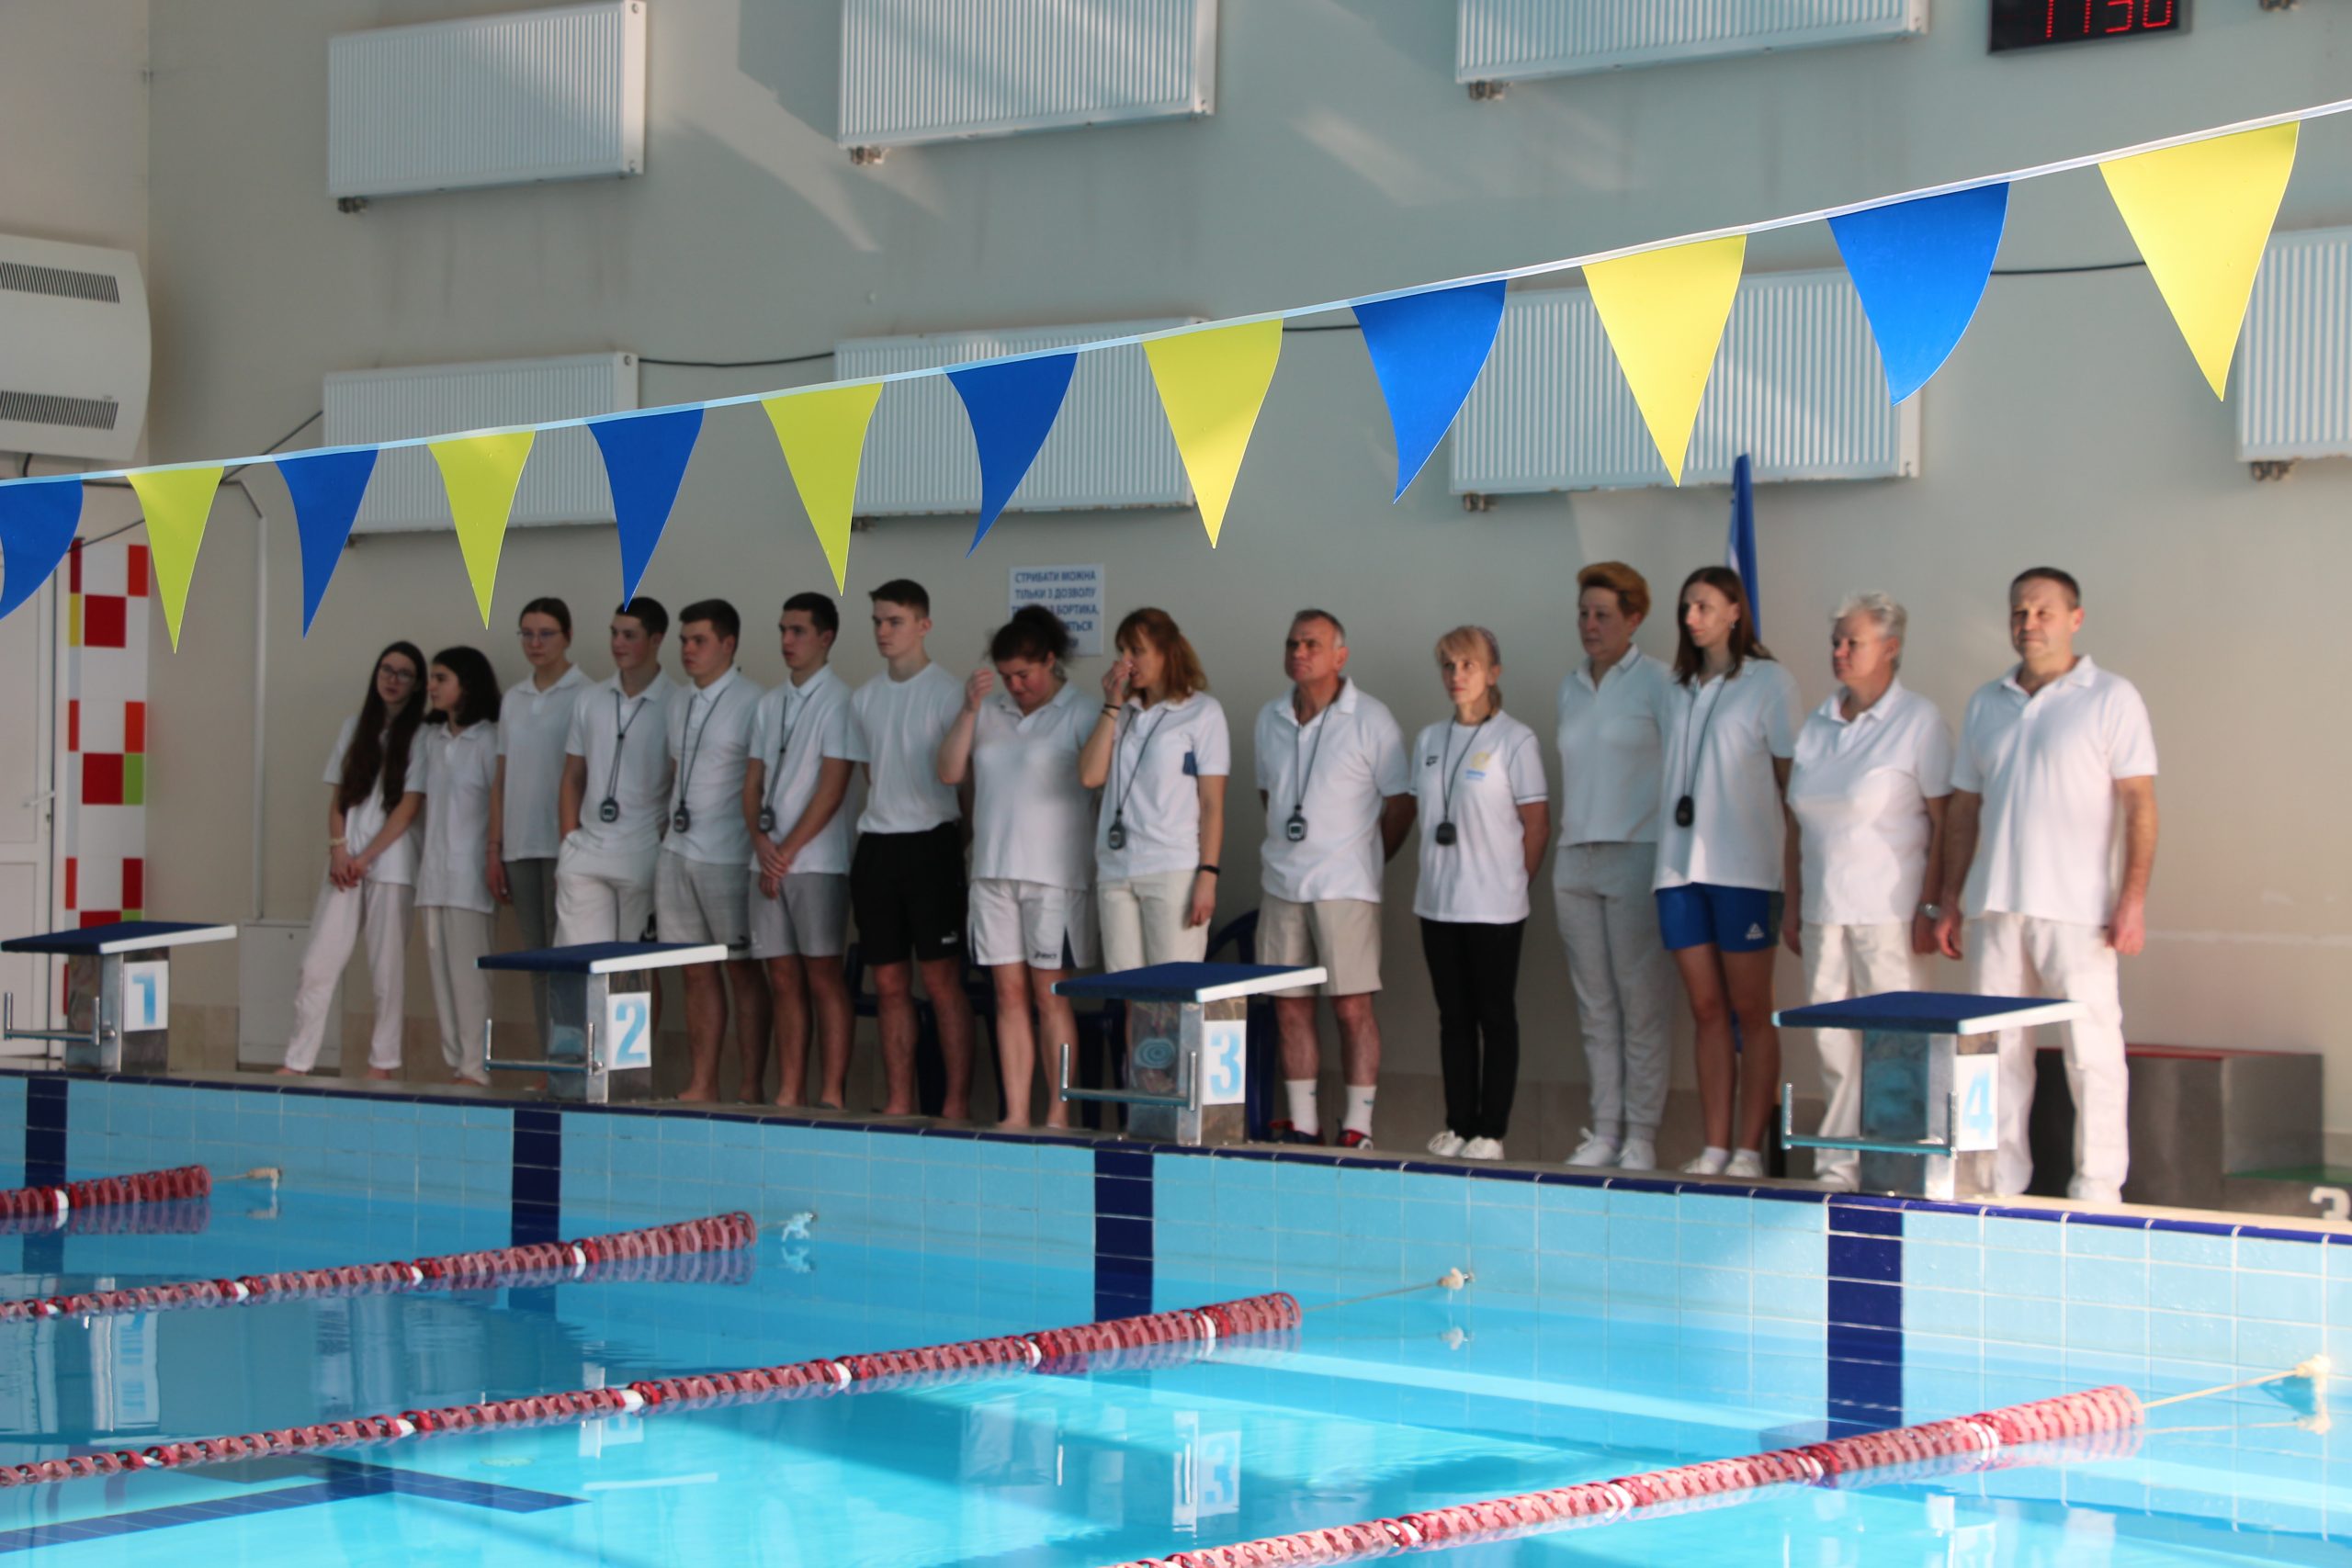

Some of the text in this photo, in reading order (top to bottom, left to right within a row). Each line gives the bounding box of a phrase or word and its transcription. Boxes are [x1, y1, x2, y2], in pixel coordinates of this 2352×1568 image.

[1015, 570, 1096, 583] СТРИБАТИ МОЖНА
[1015, 589, 1046, 600] ТІЛЬКИ
[1054, 587, 1097, 600] ДОЗВОЛУ
[132, 972, 156, 1026] 1
[616, 999, 647, 1066] 2
[1210, 1031, 1241, 1098] 3
[1962, 1070, 1994, 1139] 4
